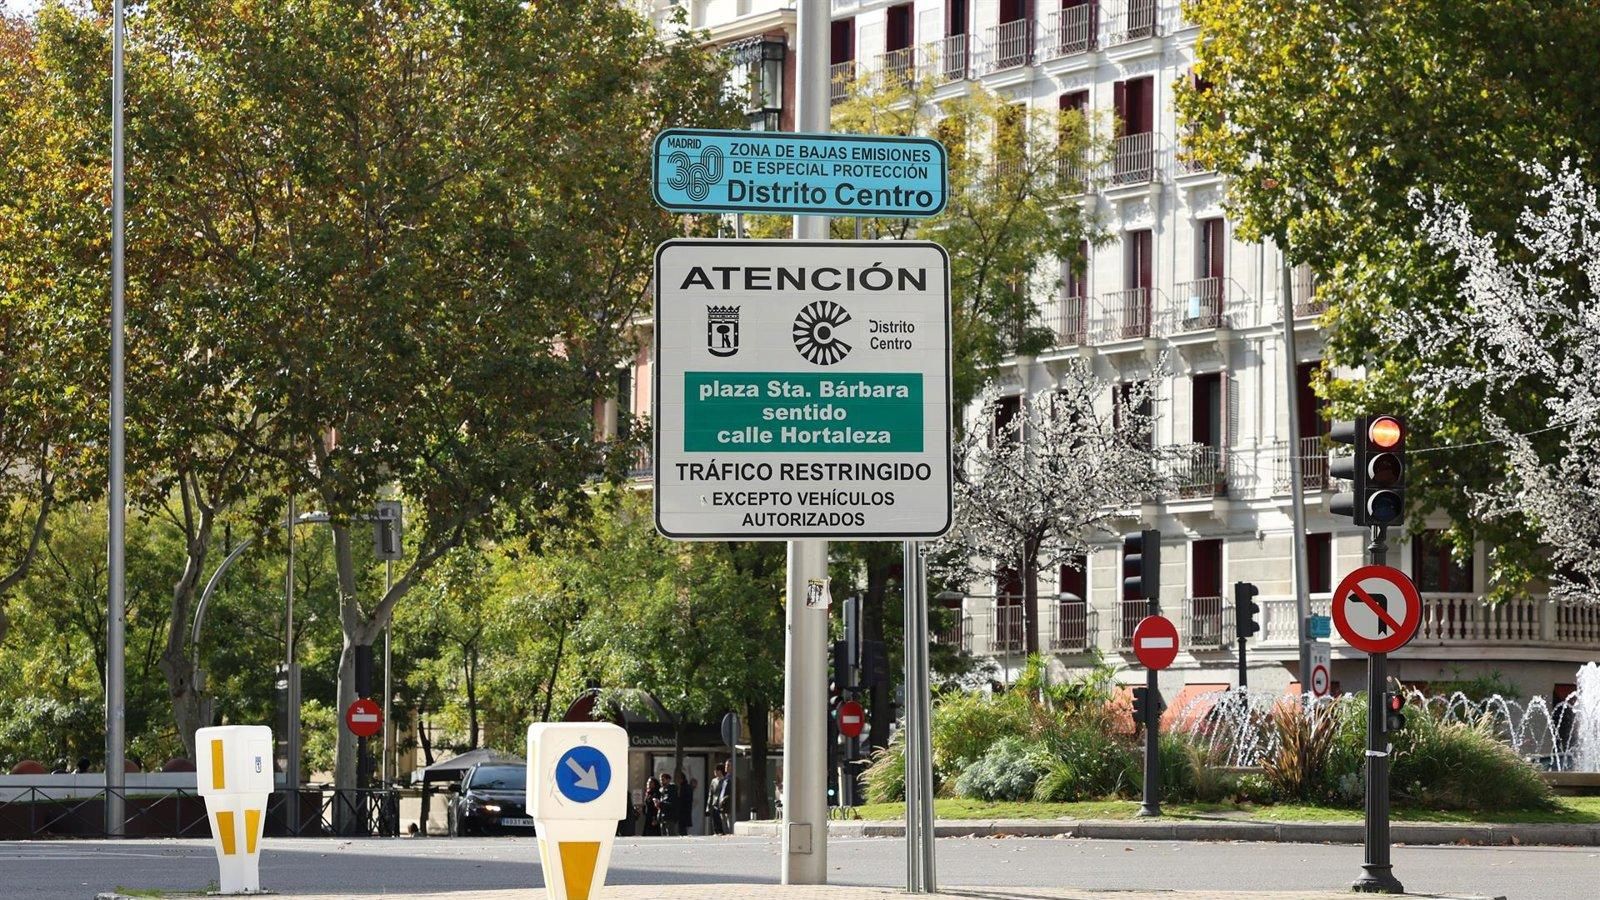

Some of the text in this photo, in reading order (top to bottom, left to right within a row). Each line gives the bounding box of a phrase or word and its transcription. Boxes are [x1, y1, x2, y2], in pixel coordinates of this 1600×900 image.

[667, 138, 702, 149] MADRID
[730, 143, 931, 162] ZONA DE BAJAS EMISIONES
[733, 161, 928, 179] DE ESPECIAL PROTECCIÓN
[728, 180, 933, 208] Distrito Centro
[680, 262, 926, 291] ATENCIÓN
[869, 319, 915, 333] Distrito
[870, 336, 912, 350] Centro
[700, 381, 909, 401] plaza Sta. Bárbara
[762, 404, 847, 421] sentido
[717, 427, 891, 443] calle Hortaleza
[676, 459, 932, 481] TRÁFICO RESTRINGIDO
[712, 489, 895, 506] EXCEPTO VEHÍCULOS
[742, 513, 865, 527] AUTORIZADOS
